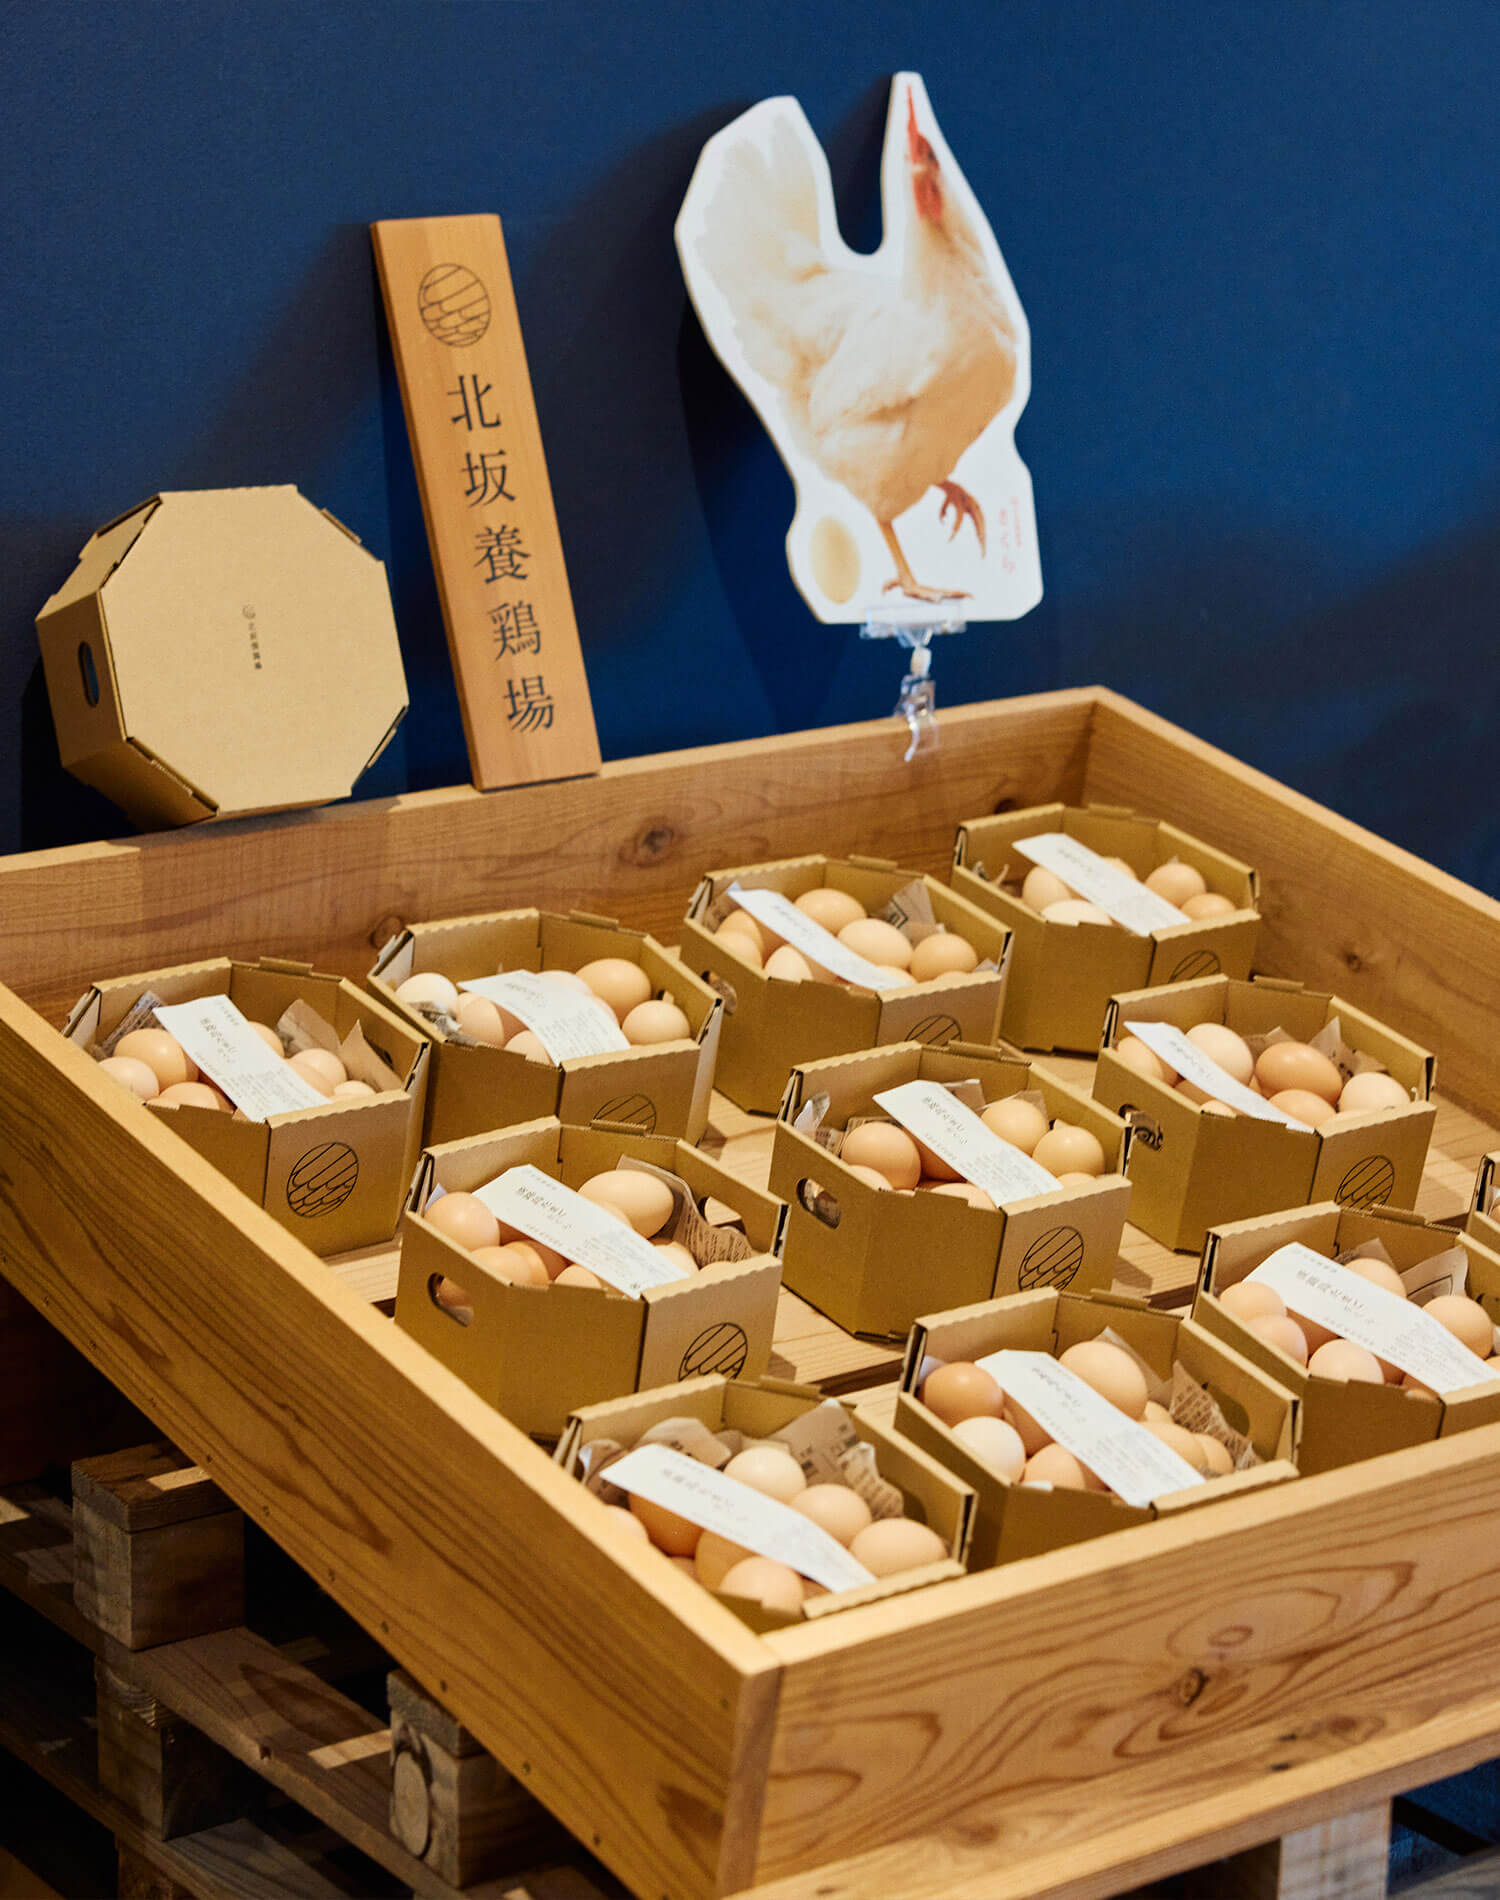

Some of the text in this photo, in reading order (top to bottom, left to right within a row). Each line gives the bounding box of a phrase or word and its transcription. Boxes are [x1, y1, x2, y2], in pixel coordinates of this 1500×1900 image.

[447, 375, 554, 733] 北坂養鶏場
